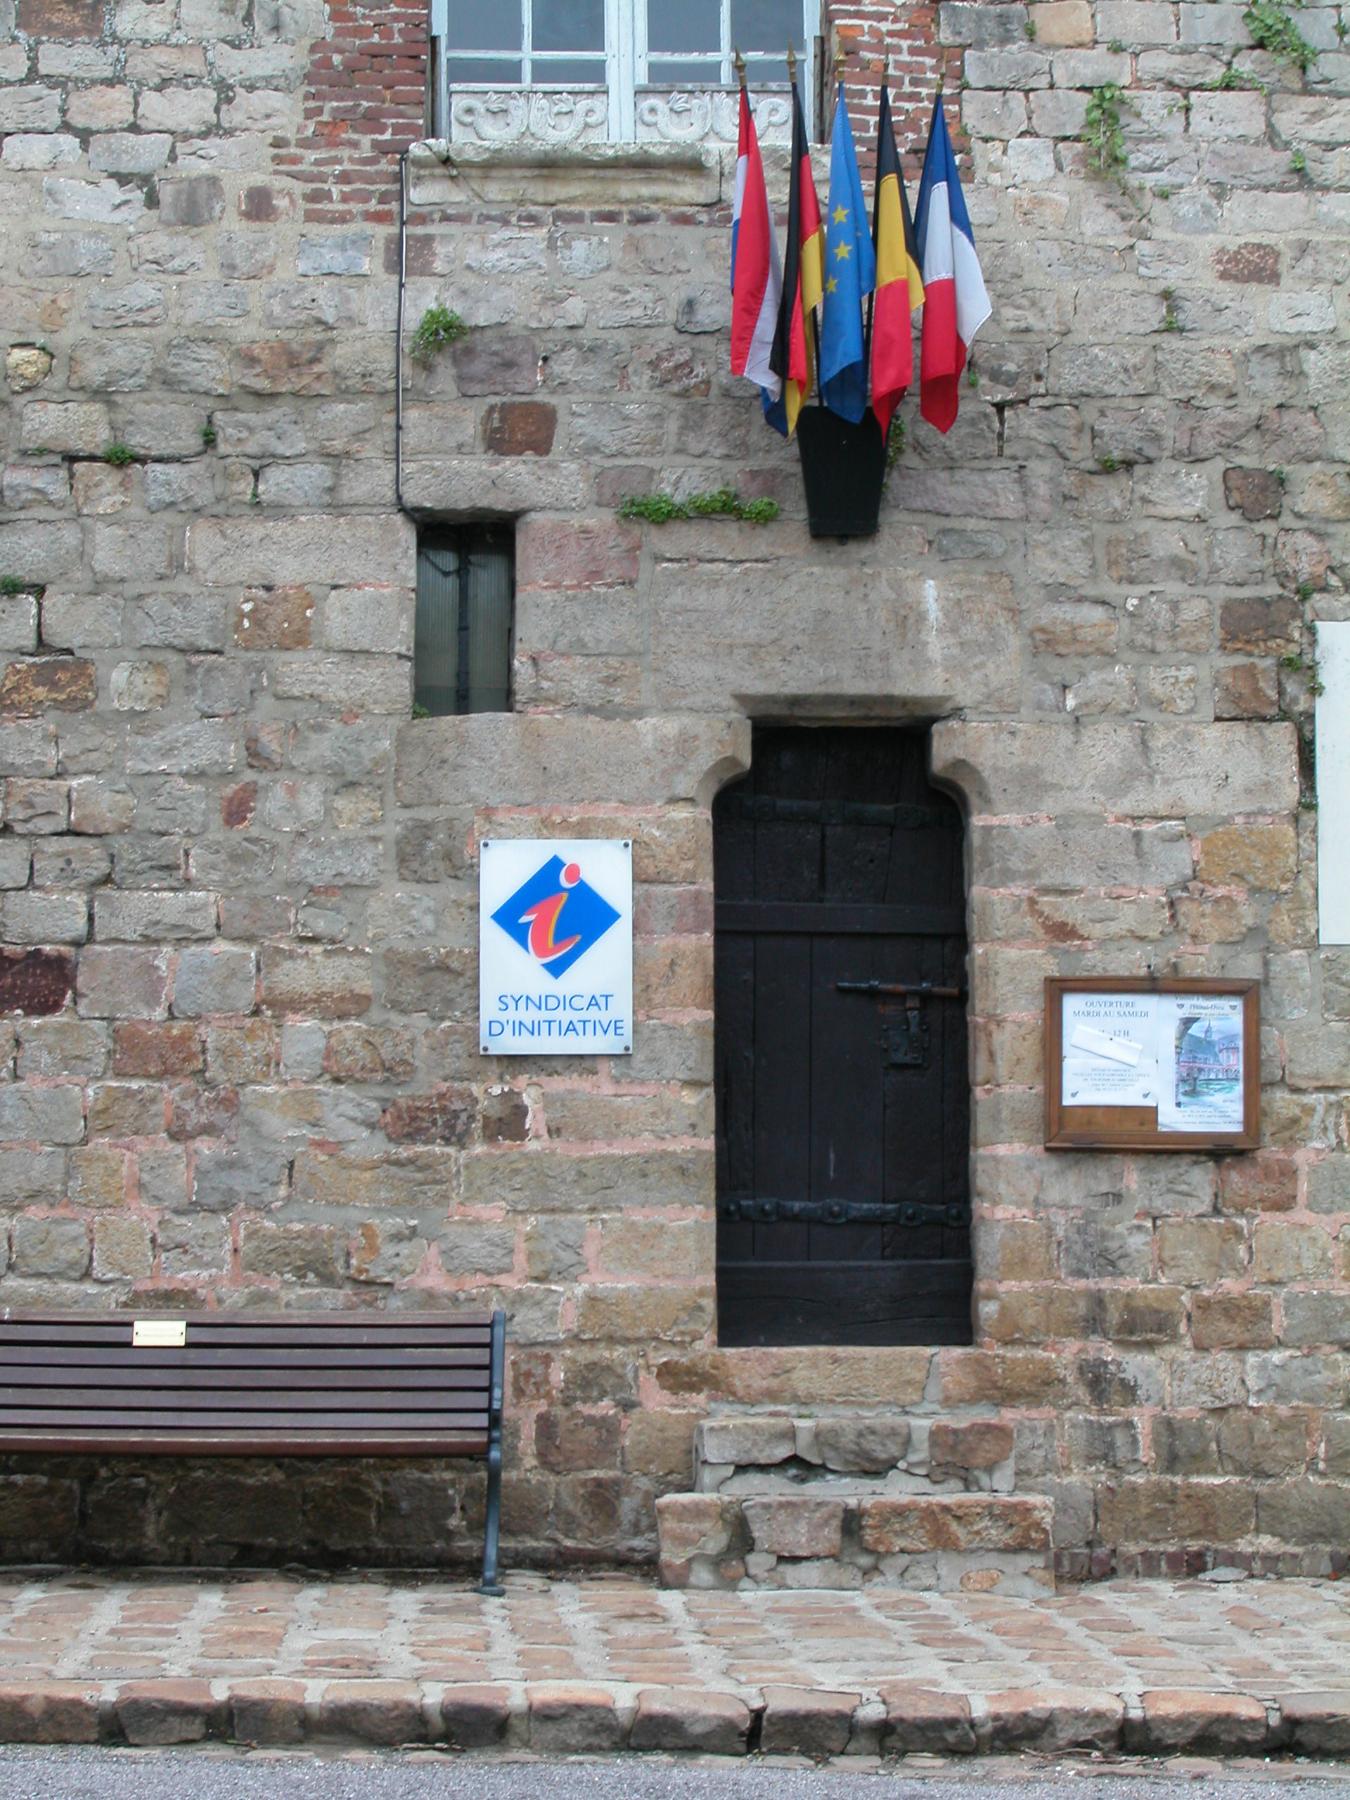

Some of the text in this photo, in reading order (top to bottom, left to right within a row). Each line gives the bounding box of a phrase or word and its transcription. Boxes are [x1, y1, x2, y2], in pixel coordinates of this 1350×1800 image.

[498, 994, 614, 1012] SYNDICAT
[1085, 1000, 1136, 1008] OUVERTURE
[1073, 1010, 1149, 1018] MARDI AU SAMEDI
[488, 1019, 625, 1037] D'INITIATIVE
